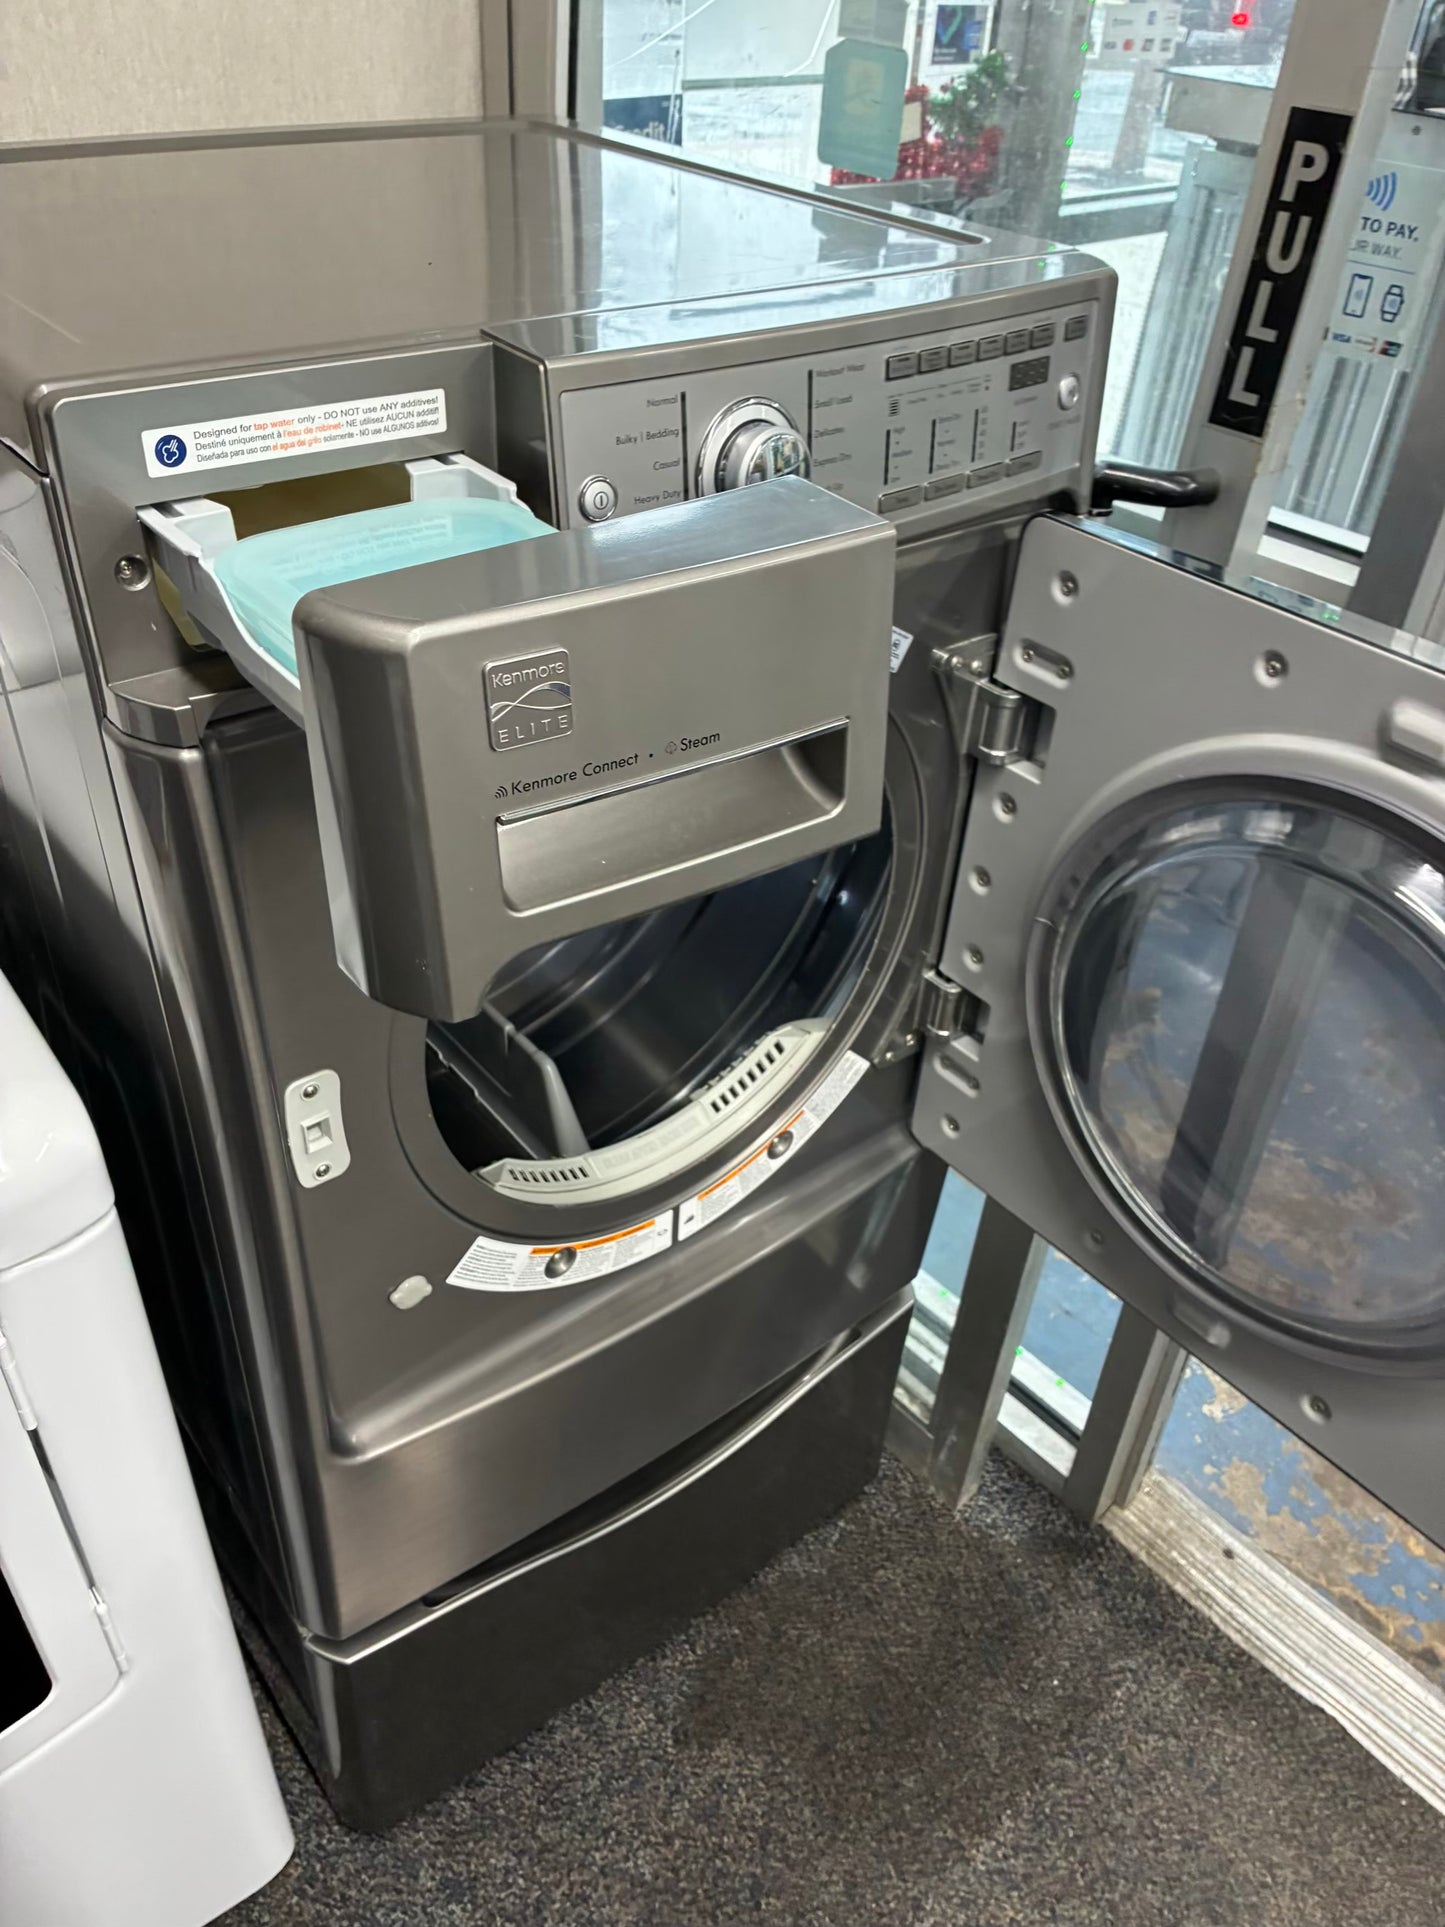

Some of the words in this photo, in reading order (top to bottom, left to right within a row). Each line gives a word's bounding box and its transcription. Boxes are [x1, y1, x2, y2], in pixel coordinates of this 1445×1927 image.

[1361, 216, 1382, 233] TO
[1385, 221, 1419, 242] PAY.
[1228, 140, 1330, 407] PULL
[193, 425, 237, 439] Designed
[240, 424, 252, 433] for
[253, 422, 269, 431] tap
[270, 419, 295, 428] water
[298, 414, 316, 424] only
[323, 410, 338, 420] DO
[341, 405, 360, 417] NOT
[380, 401, 399, 412] ANY
[401, 396, 438, 408] additives!
[195, 439, 226, 451] Destiné
[229, 432, 275, 446] uniquement
[276, 430, 282, 439] à
[283, 429, 301, 438] l'eau
[303, 426, 314, 434] de
[346, 418, 358, 428] NE
[359, 415, 384, 426] utilisez
[386, 411, 414, 422] AUCUN
[230, 449, 245, 459] para
[259, 445, 271, 453] con
[279, 441, 295, 451] agua
[359, 427, 369, 437] NO
[370, 428, 381, 436] use
[383, 421, 414, 433] ALGUNOS
[616, 434, 637, 445] Bulky
[646, 428, 679, 440] Bedding
[634, 494, 660, 504] Heavy
[662, 489, 682, 500] Duty
[492, 661, 565, 688] Kenmore
[497, 714, 568, 743] ELITE
[511, 770, 577, 796] Kenmore
[582, 753, 639, 777] Connect
[680, 731, 721, 752] Steam
